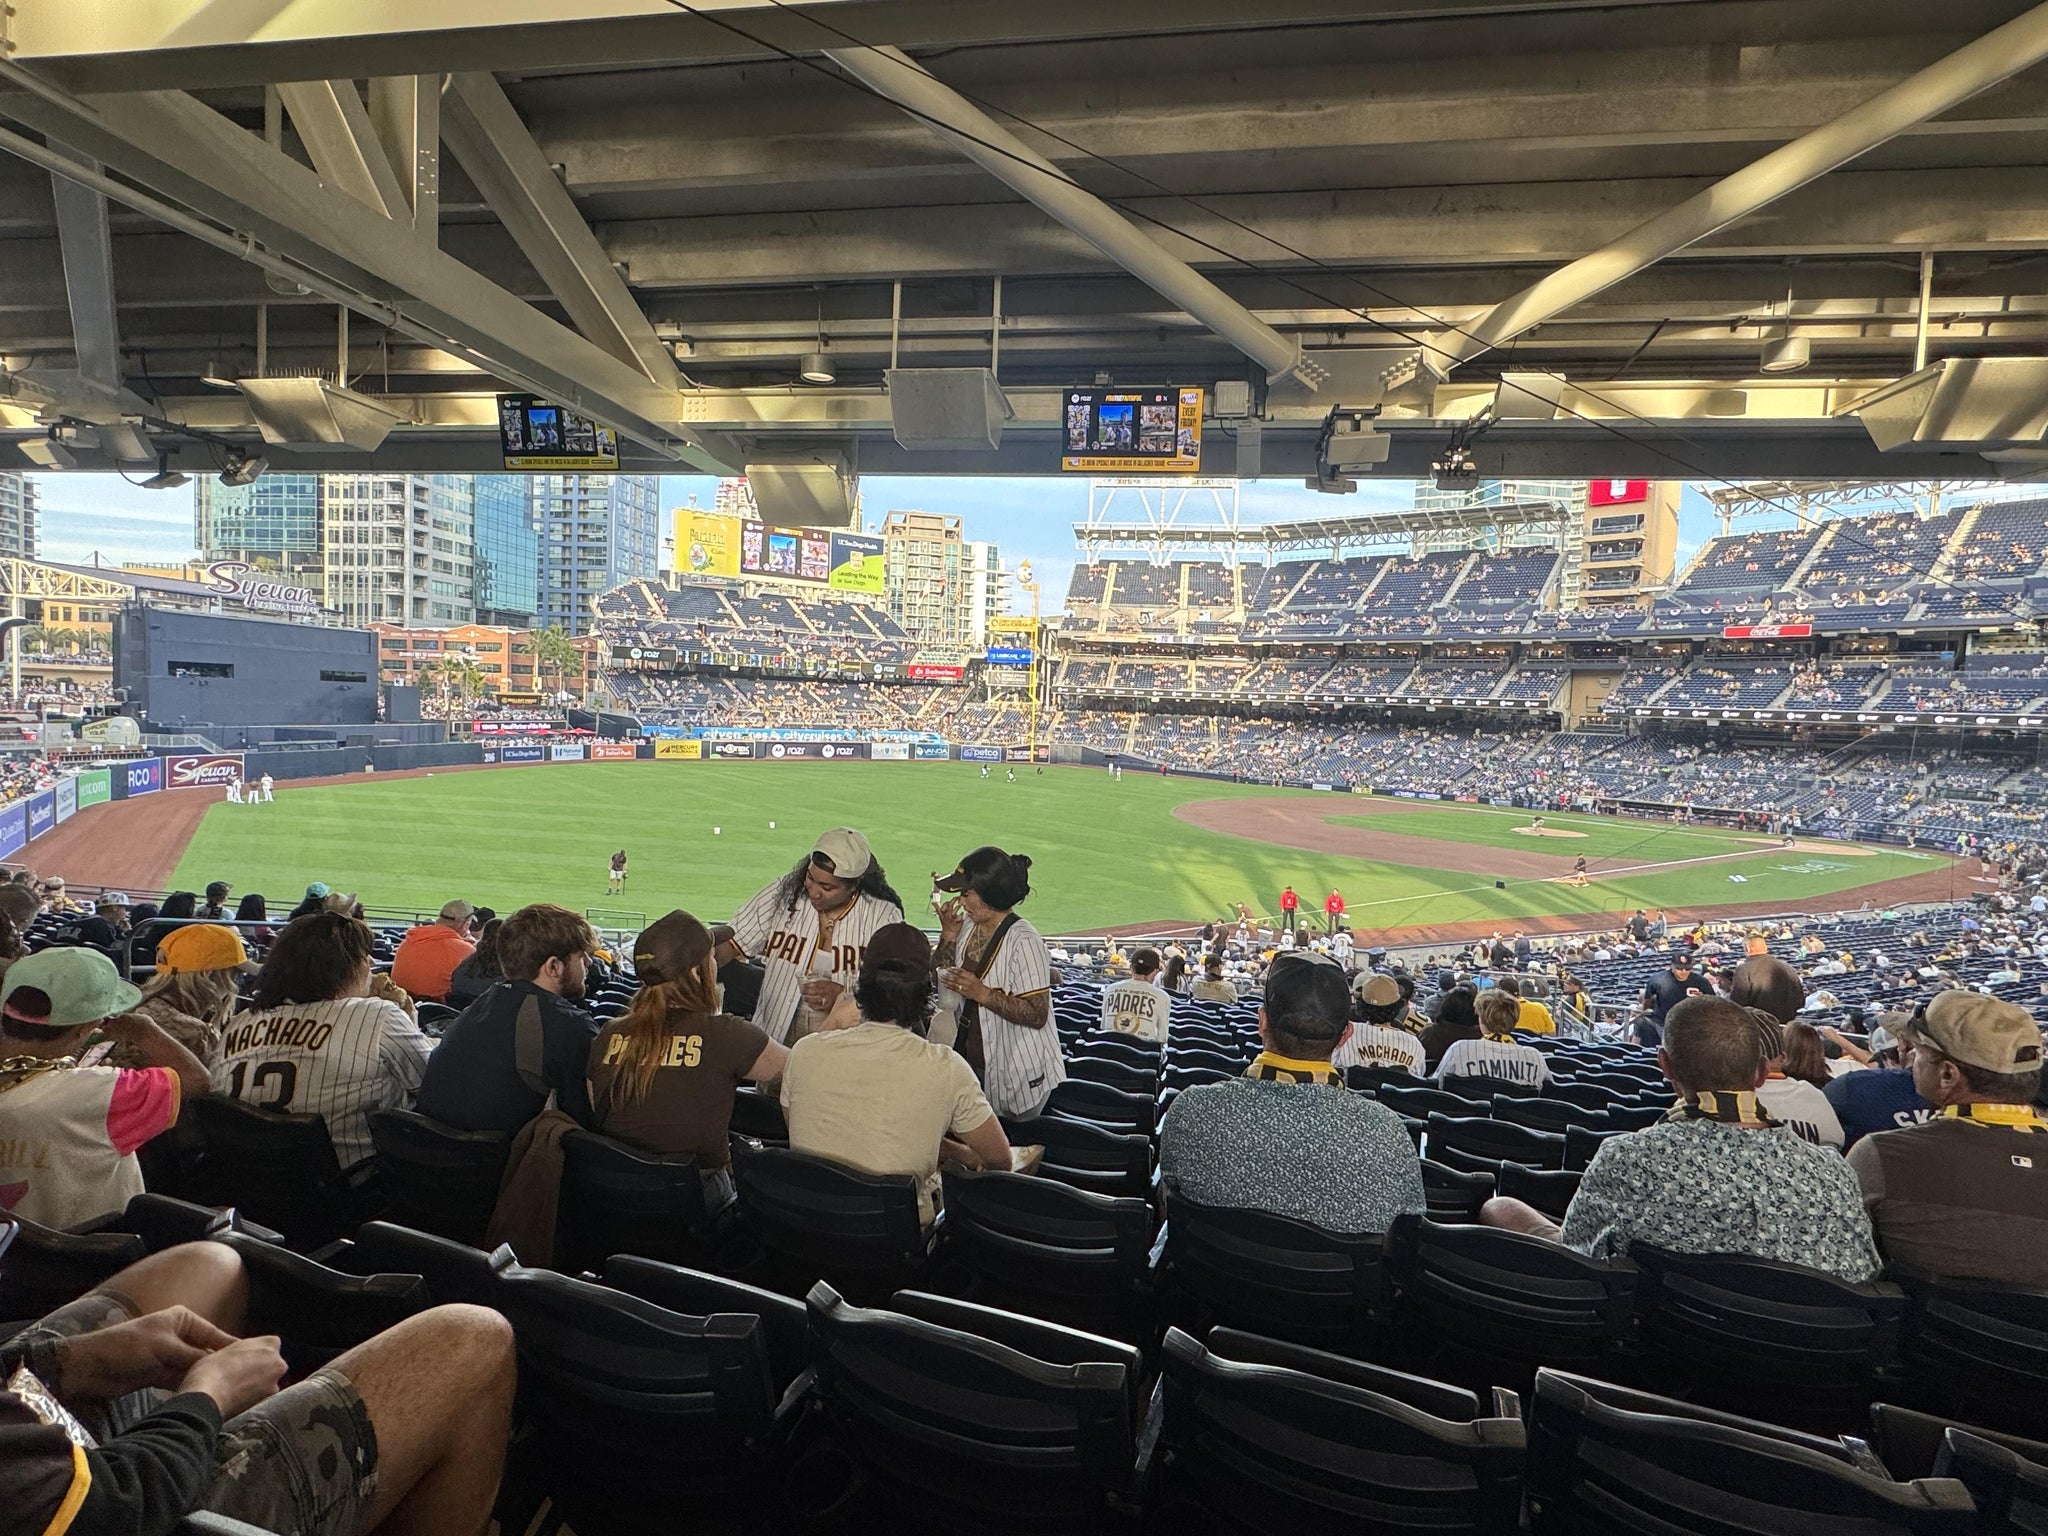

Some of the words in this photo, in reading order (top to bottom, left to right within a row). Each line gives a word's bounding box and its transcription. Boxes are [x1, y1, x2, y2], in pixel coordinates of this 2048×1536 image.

[205, 561, 317, 608] Sycuan
[787, 746, 806, 755] razr
[836, 746, 854, 755] razr
[974, 747, 998, 757] petco
[173, 758, 237, 784] Sycuan
[1107, 993, 1156, 1018] PADRES
[224, 1016, 334, 1059] MACHADO
[1357, 1045, 1414, 1066] MACHADO
